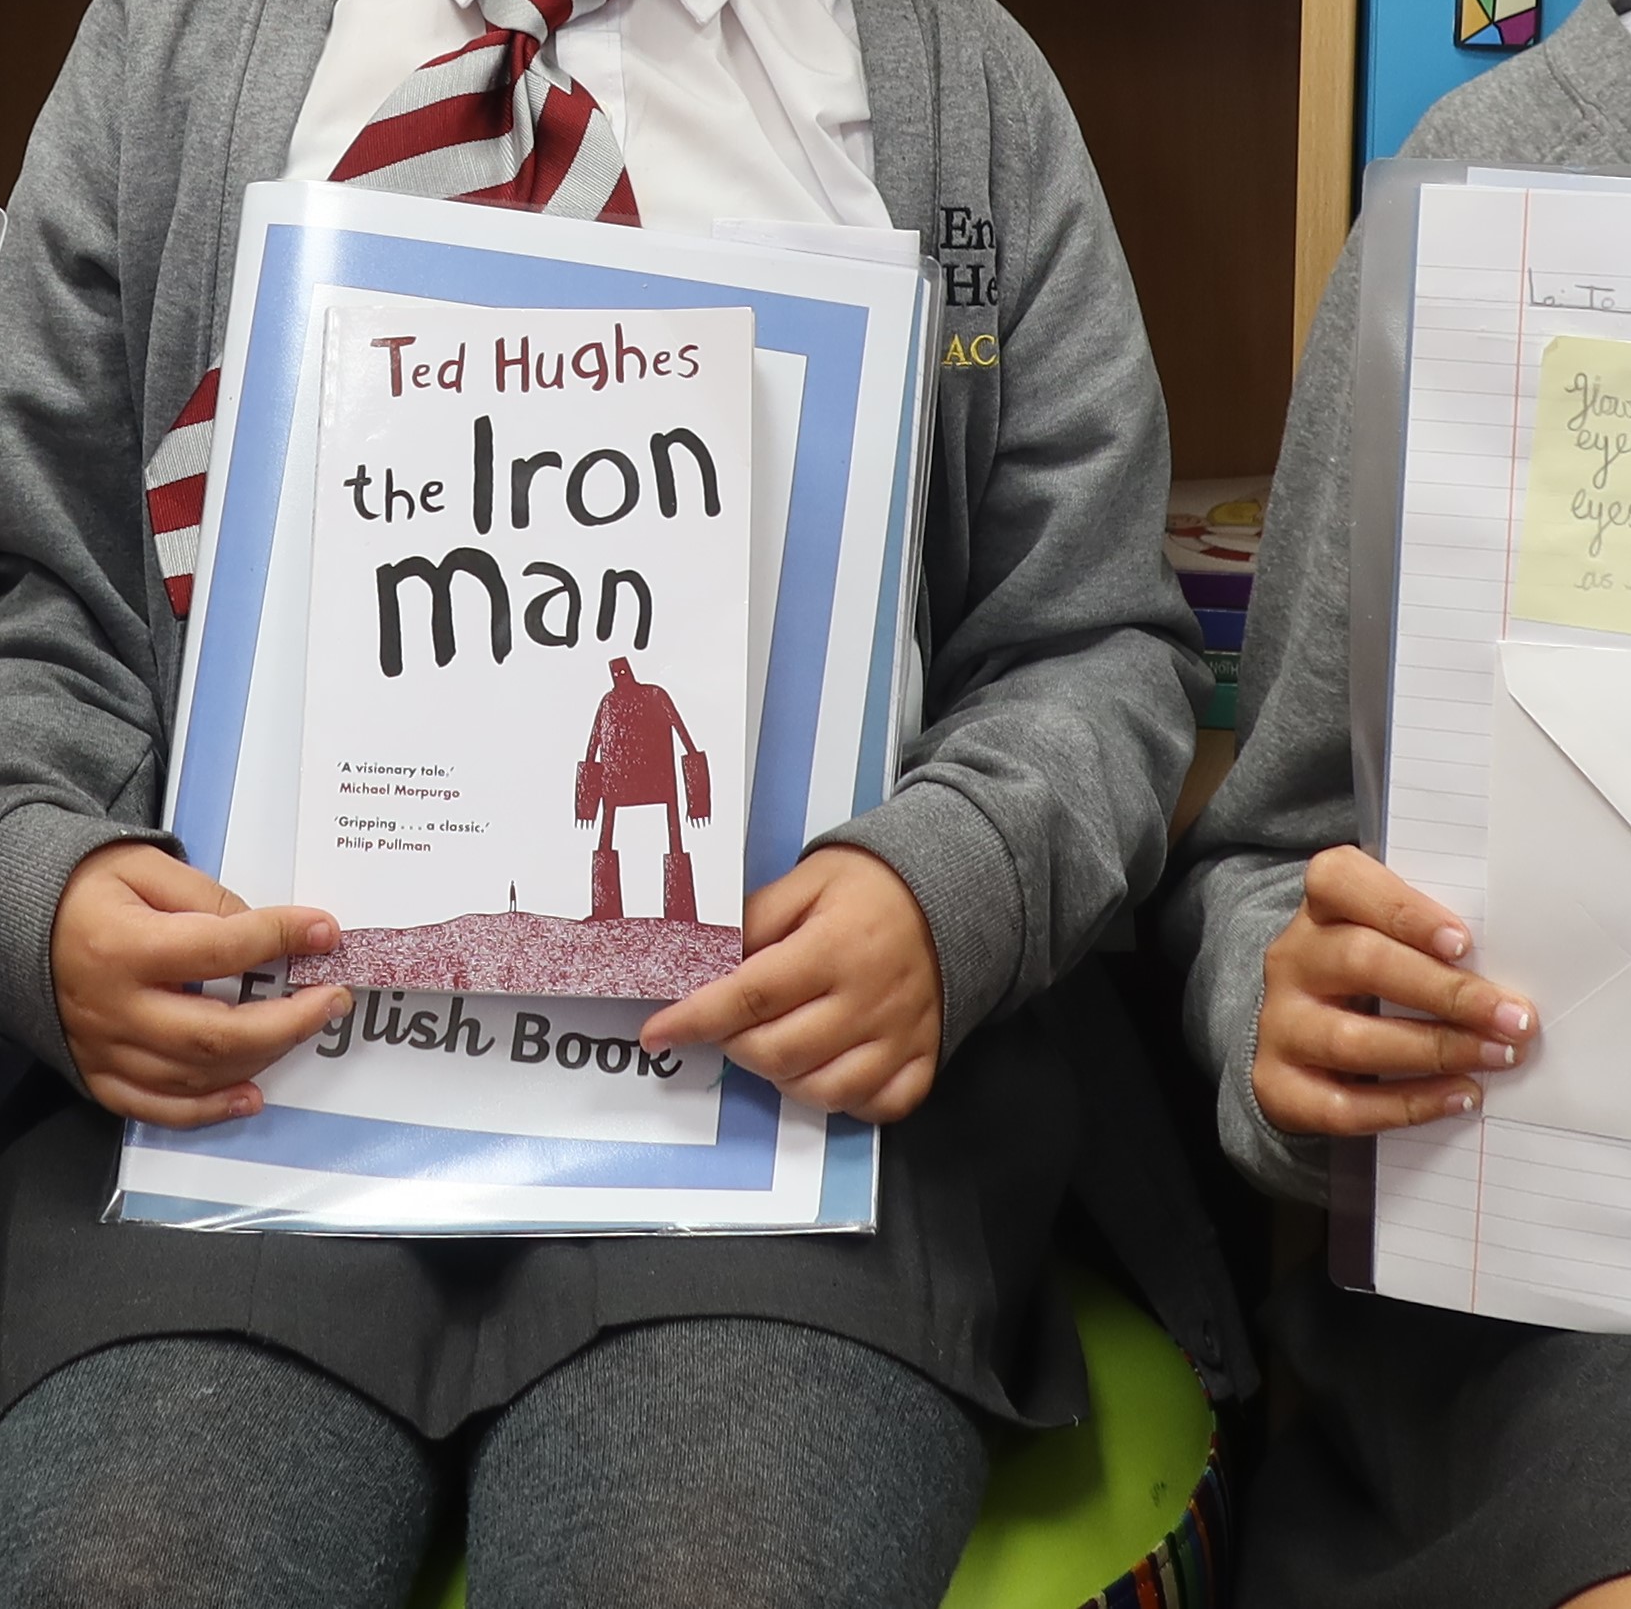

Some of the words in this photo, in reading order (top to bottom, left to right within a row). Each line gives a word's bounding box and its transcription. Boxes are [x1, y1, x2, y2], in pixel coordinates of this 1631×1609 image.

[1574, 283, 1617, 312] To
[369, 334, 466, 398] Ted
[494, 321, 701, 394] Hughes
[342, 463, 446, 524] the
[471, 414, 722, 536] Iron
[355, 762, 417, 779] visionary
[339, 782, 391, 795] Michael
[394, 784, 461, 801] Morpurgo
[426, 821, 435, 831] a
[336, 836, 374, 853] Philip
[377, 838, 432, 852] Pullman
[237, 970, 496, 1059] Eglish
[508, 1010, 684, 1080] Book
